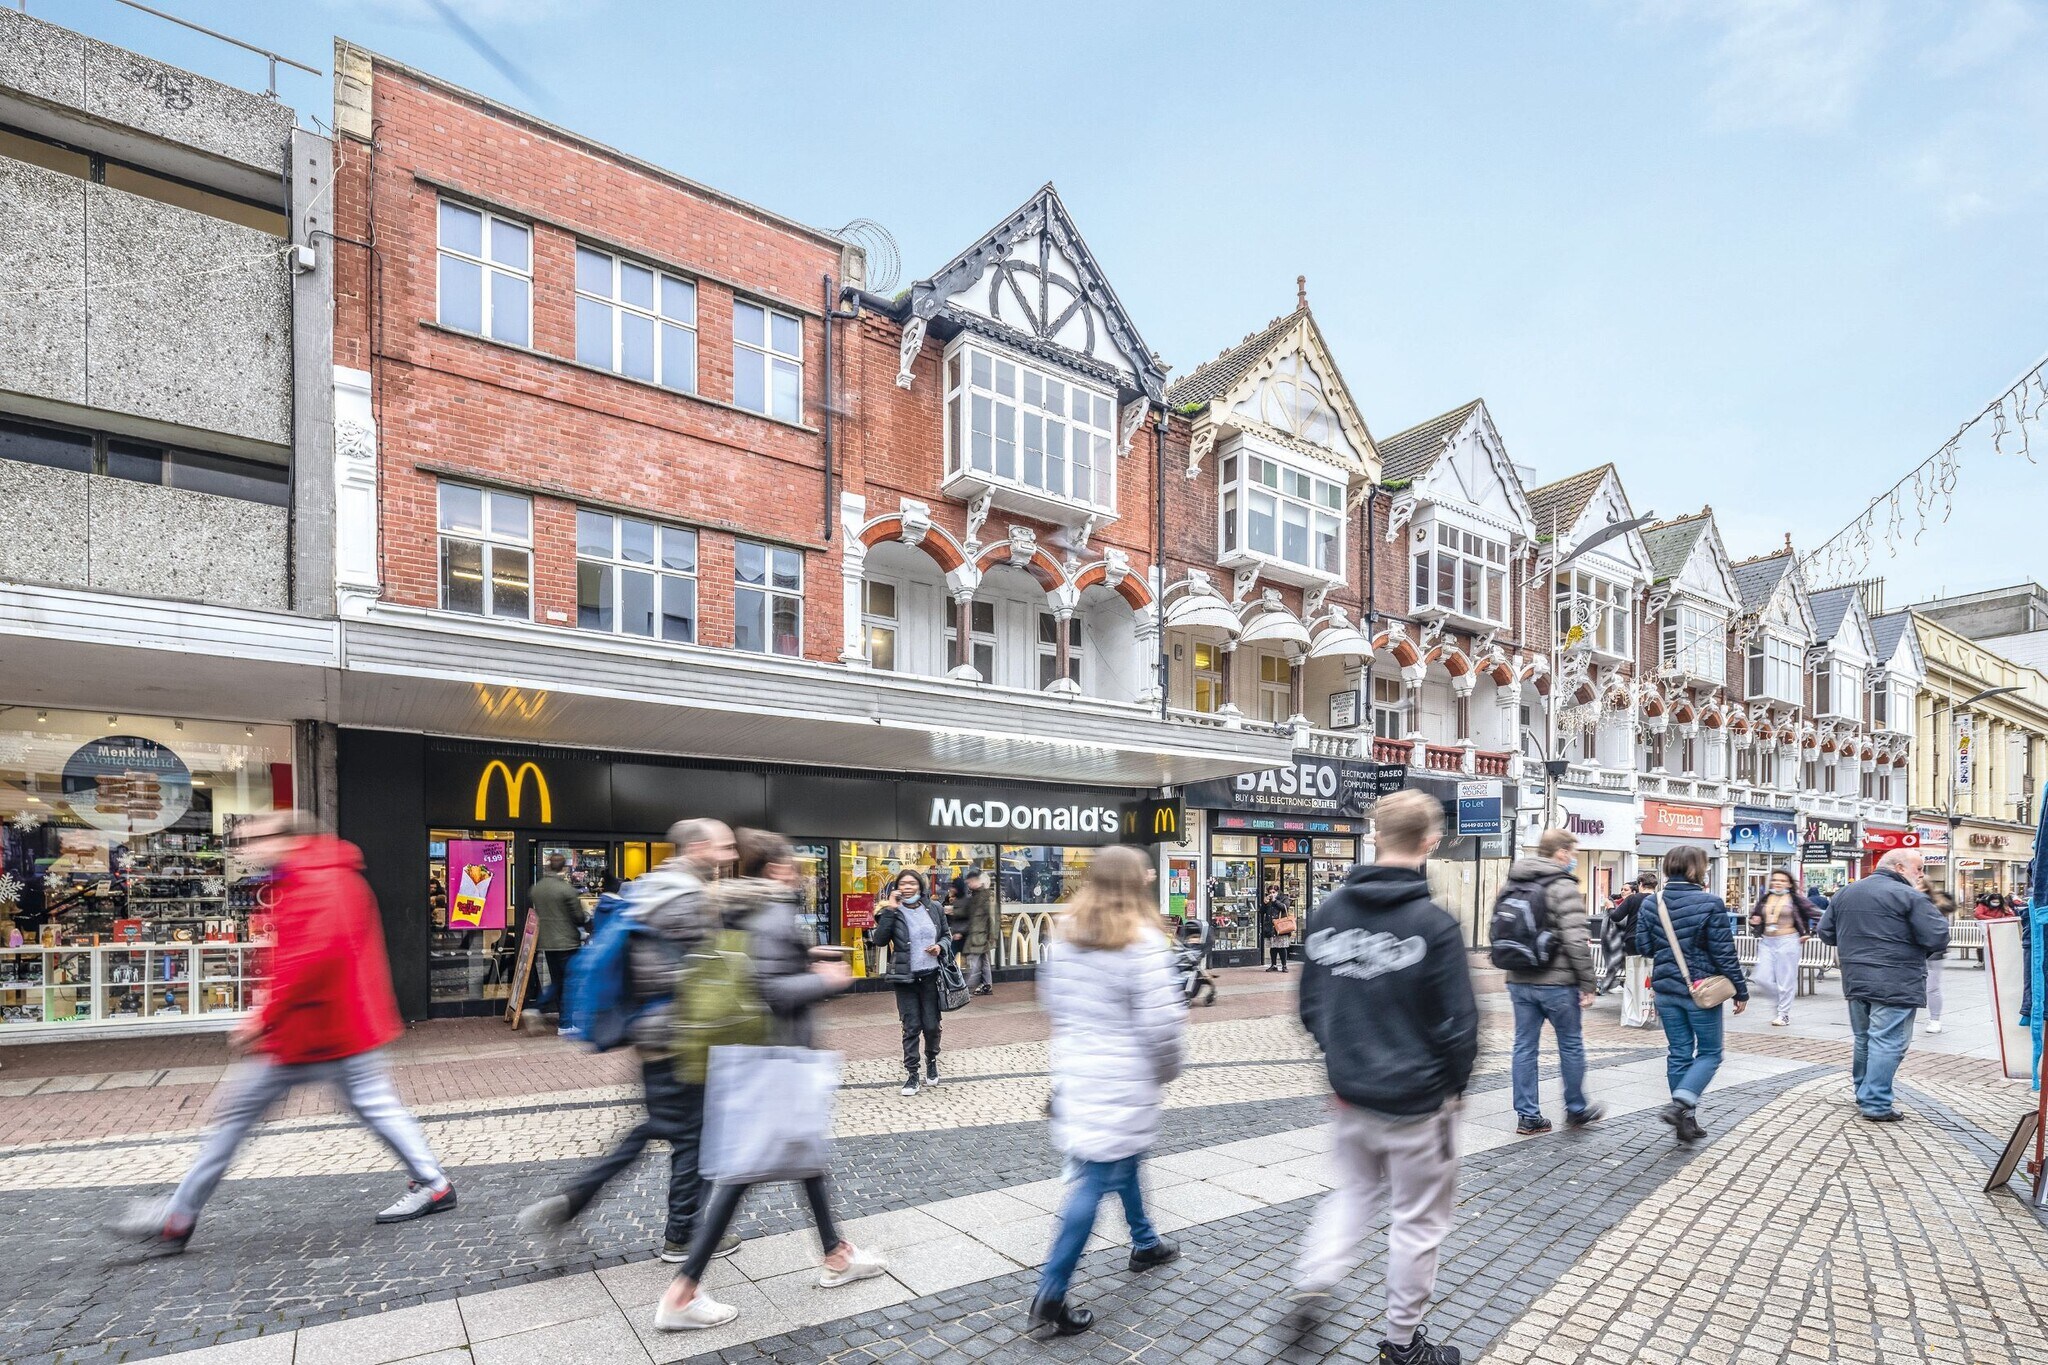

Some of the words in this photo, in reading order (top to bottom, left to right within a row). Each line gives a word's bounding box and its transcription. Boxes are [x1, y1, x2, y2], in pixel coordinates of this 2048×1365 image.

[98, 745, 158, 758] MenKind
[77, 751, 176, 768] Wonderland
[1236, 762, 1337, 797] BASEO
[1341, 769, 1377, 780] ELECTRONICS
[1379, 769, 1403, 777] BASEO
[1343, 780, 1377, 790] COMPUTING
[1235, 793, 1249, 802] BUY
[1250, 795, 1255, 803] &
[1256, 795, 1270, 804] SELL
[1270, 796, 1312, 808] ELECTRONICS
[1312, 798, 1337, 809] OUTLET
[1354, 791, 1377, 800] MOBILES
[1357, 801, 1376, 810] VISION
[1460, 800, 1471, 808] To
[1472, 800, 1485, 808] Let
[928, 798, 1119, 833] McDonald's
[1657, 808, 1704, 827] Ryman
[1569, 813, 1605, 835] Three
[1818, 821, 1851, 846] iRepair
